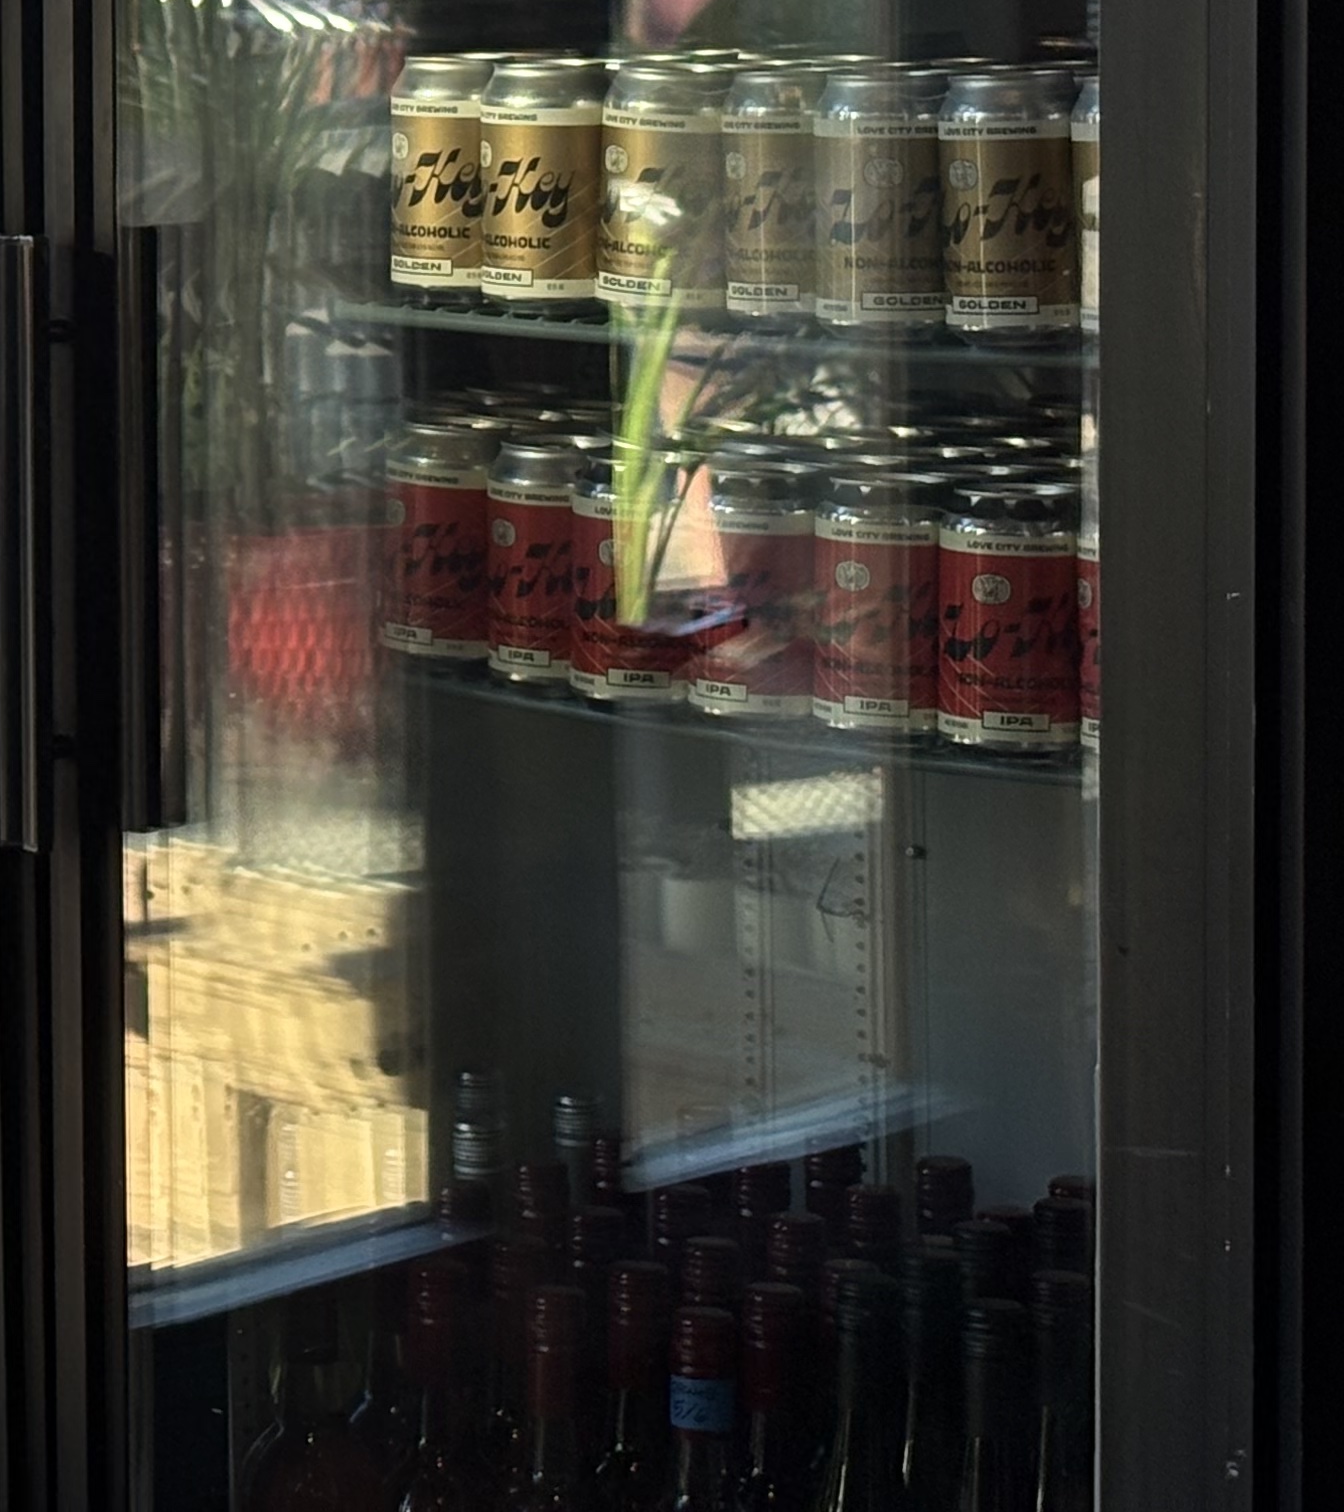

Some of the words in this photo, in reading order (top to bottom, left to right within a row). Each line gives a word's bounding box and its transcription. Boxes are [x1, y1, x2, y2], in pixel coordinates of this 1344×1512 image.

[416, 104, 458, 115] BREWING
[498, 112, 538, 123] BREWING
[639, 118, 686, 130] BREWING
[754, 121, 801, 130] BREWING
[857, 125, 886, 135] LOVE
[888, 126, 912, 135] CITY
[914, 126, 939, 135] BREW
[962, 127, 984, 136] CITY
[986, 125, 1037, 136] BREWING
[601, 276, 661, 291] GOLDEN
[731, 286, 788, 297] GOLDEN
[873, 296, 943, 307] GOLDEN
[959, 300, 1027, 311] GOLDEN
[525, 493, 570, 503] BREWING
[831, 527, 853, 537] LOVE
[855, 530, 880, 540] CITY
[967, 540, 995, 550] LOVE
[996, 542, 1022, 552] CITY
[508, 650, 535, 663] IPA
[623, 672, 656, 684] IPA
[705, 683, 732, 696] IPA
[859, 699, 893, 712] IPA
[999, 715, 1034, 728] IPA
[1087, 722, 1100, 735] IP
